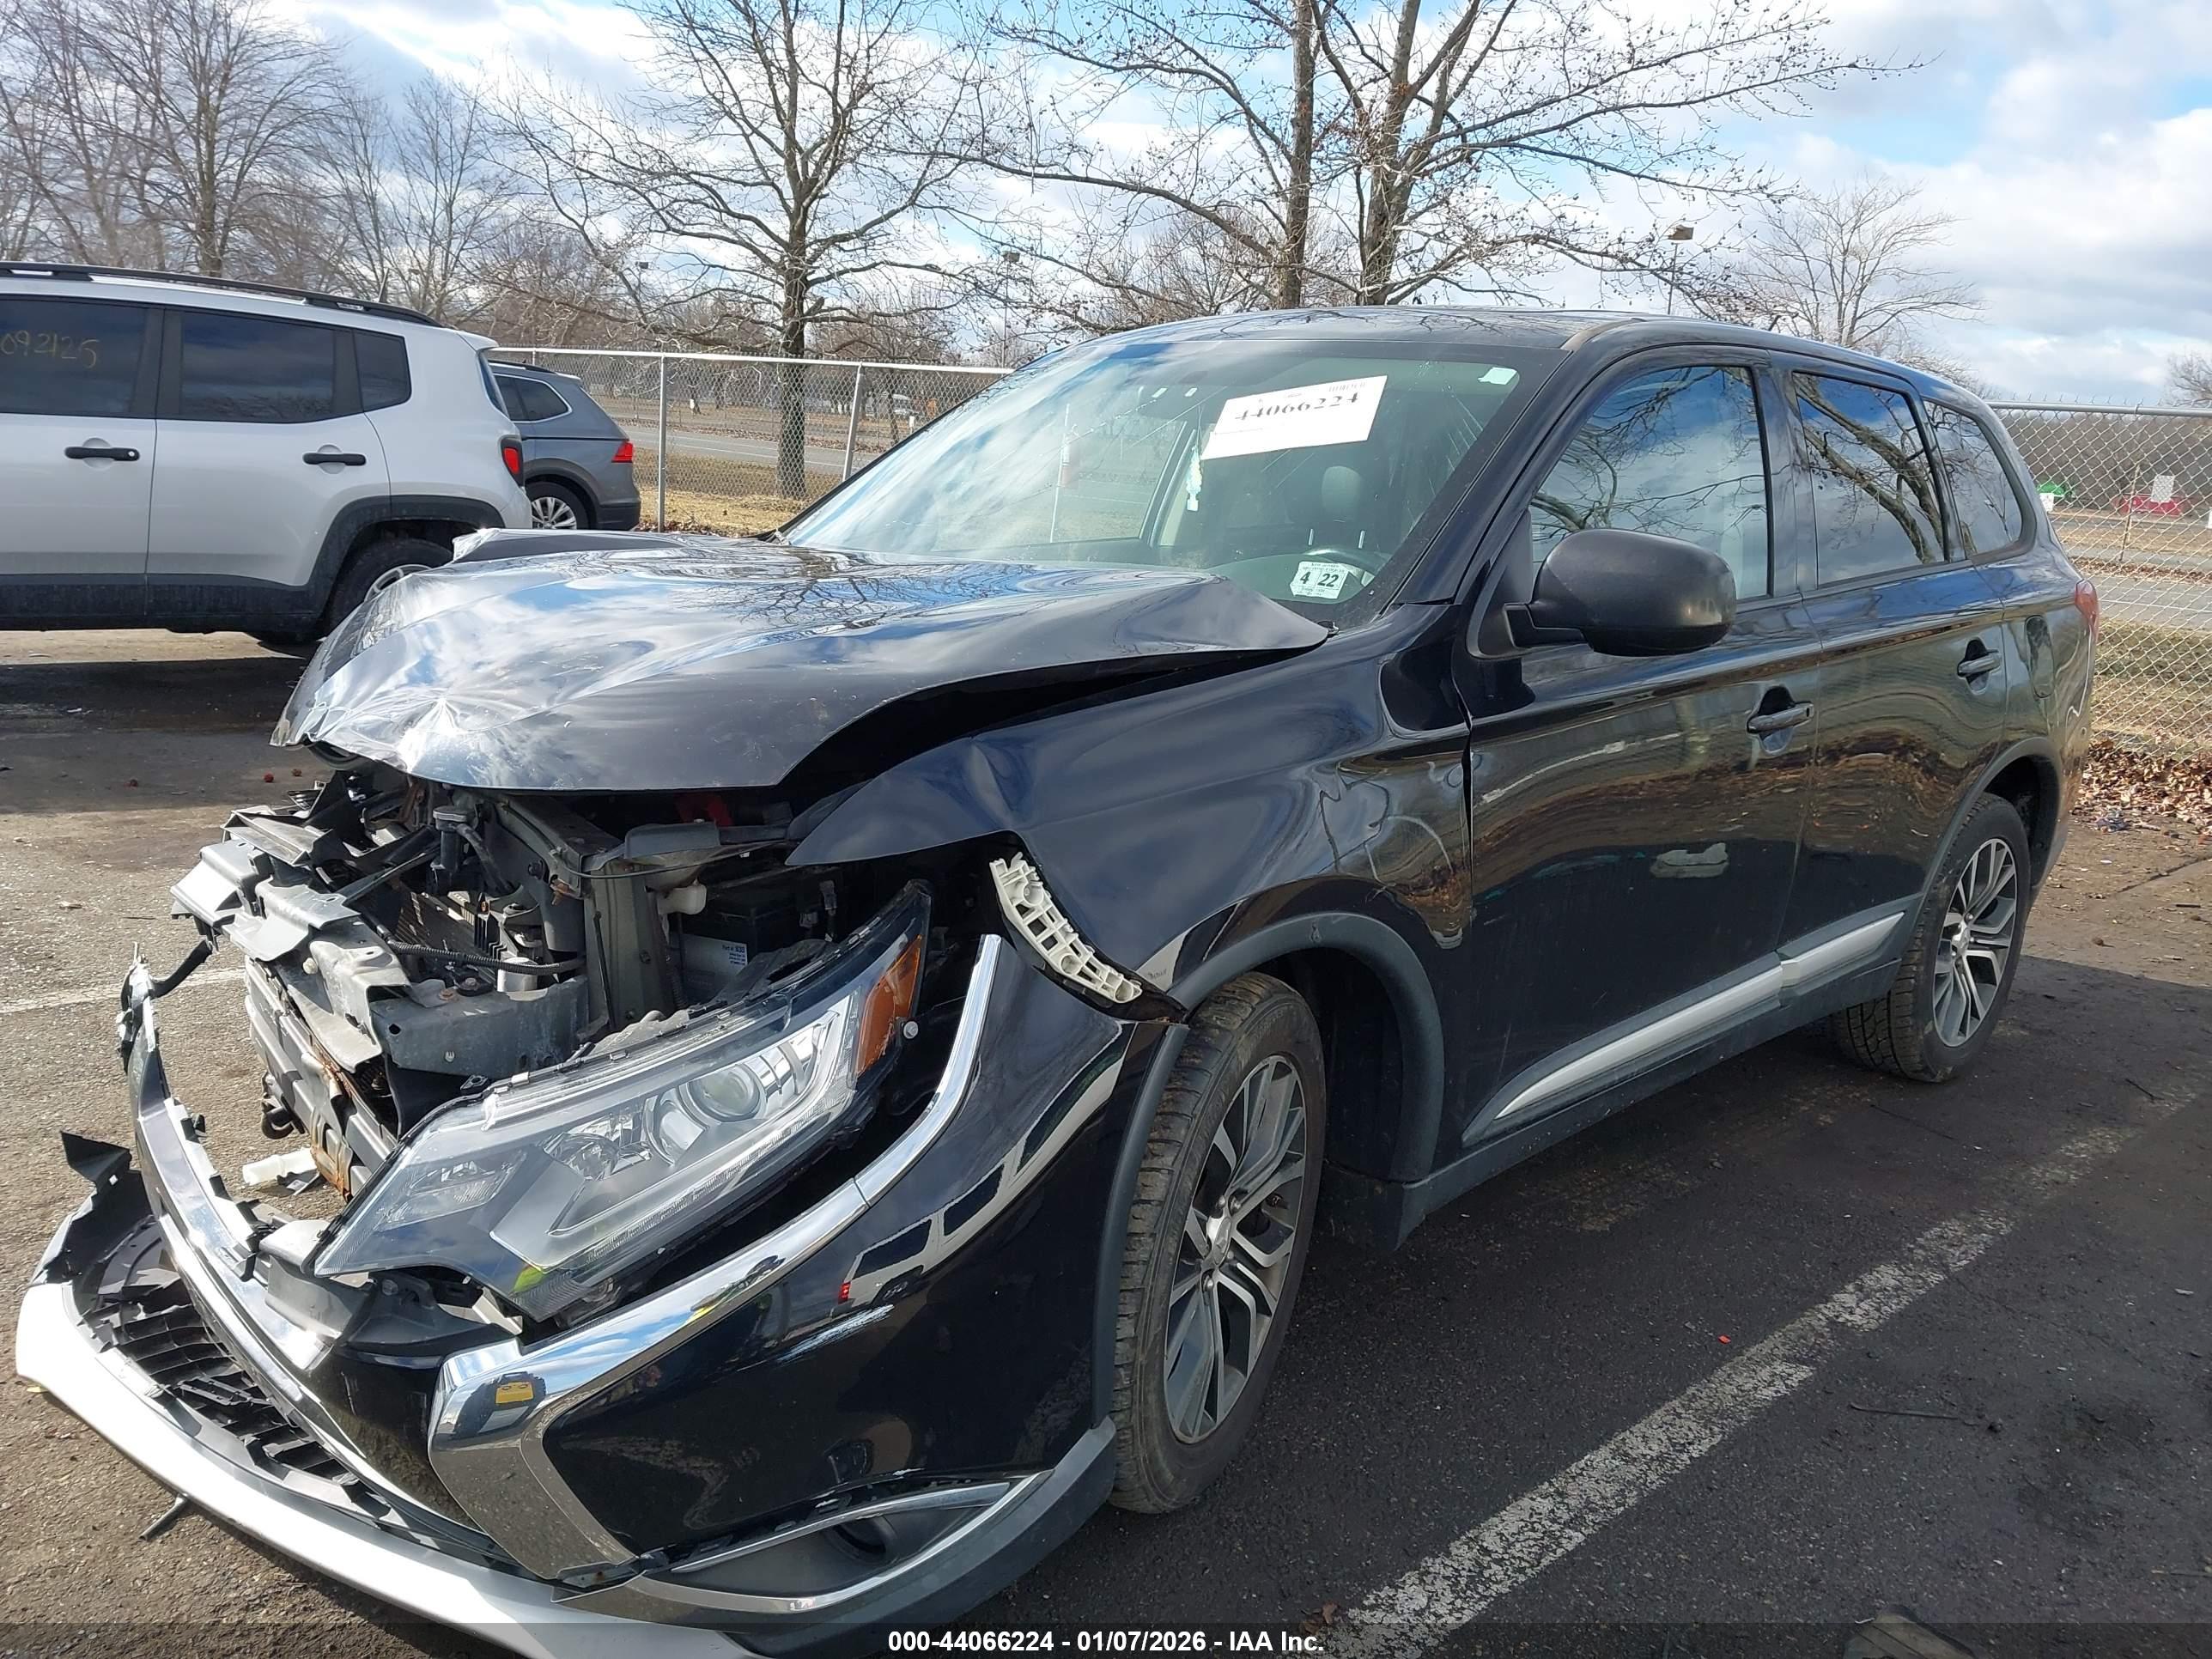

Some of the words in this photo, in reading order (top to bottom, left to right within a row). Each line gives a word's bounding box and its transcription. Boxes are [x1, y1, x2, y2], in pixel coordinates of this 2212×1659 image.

[1235, 392, 1358, 421] 44066224
[1299, 571, 1311, 585] 4
[1317, 573, 1340, 587] 22
